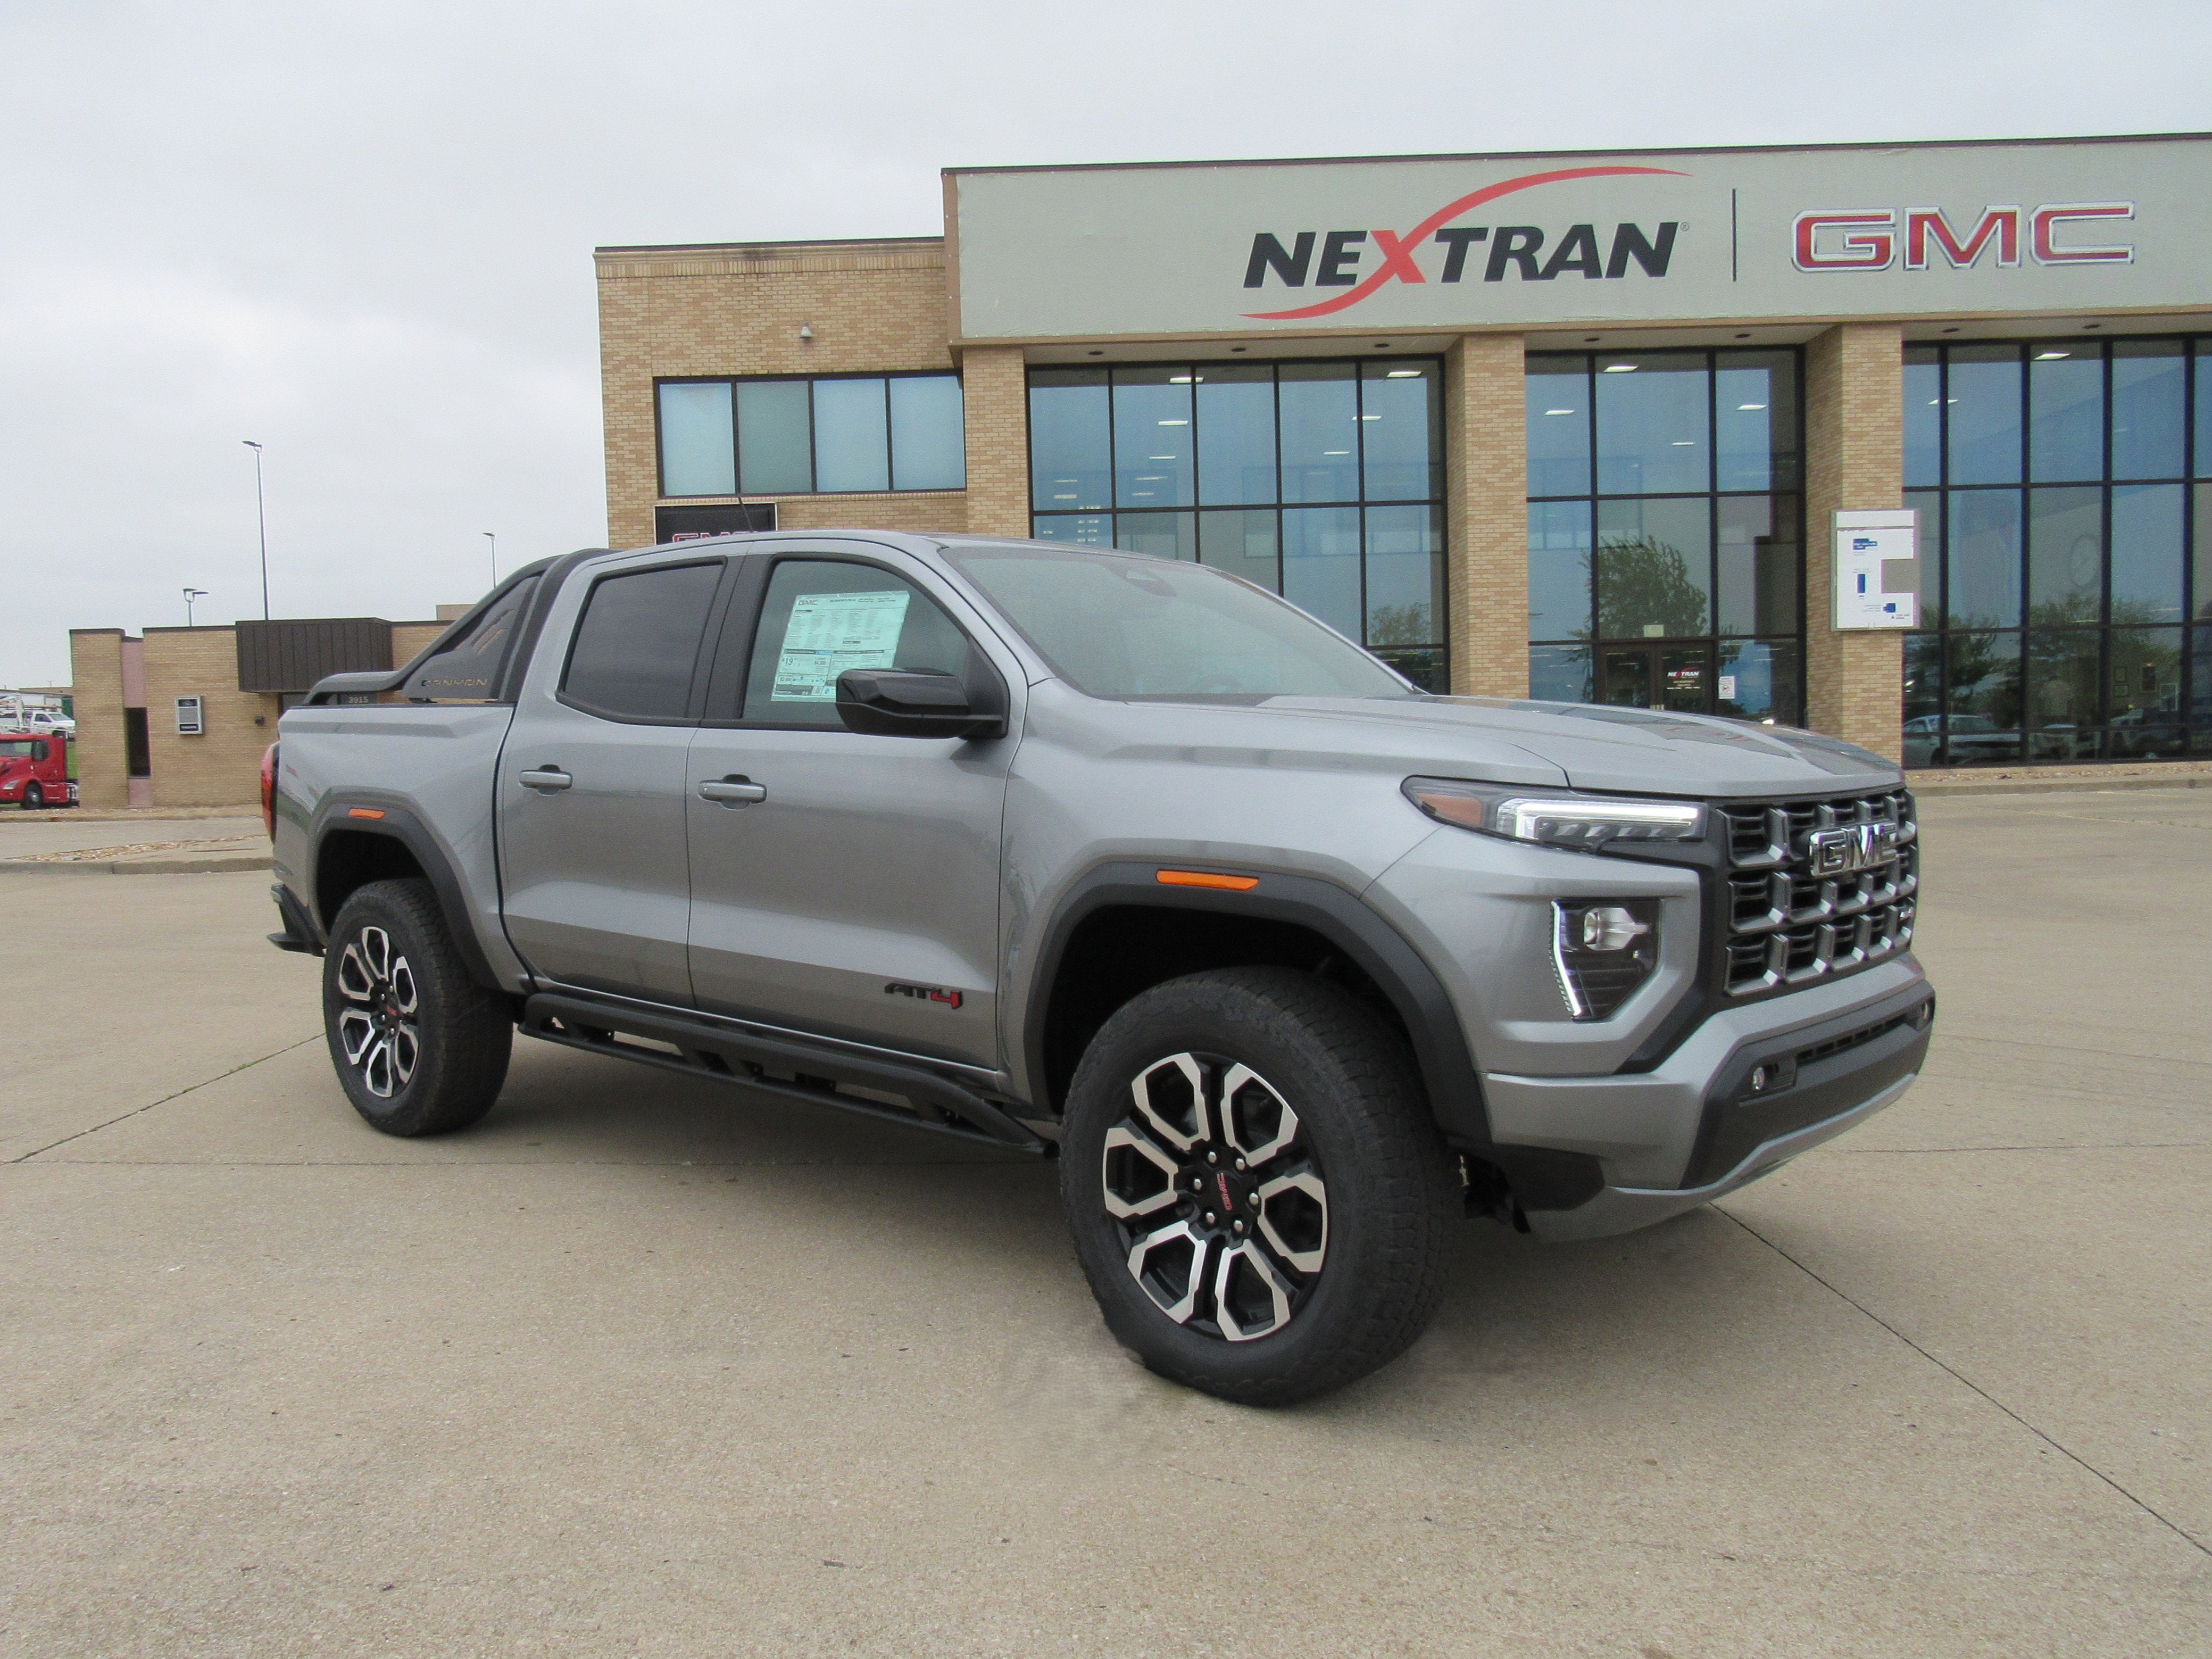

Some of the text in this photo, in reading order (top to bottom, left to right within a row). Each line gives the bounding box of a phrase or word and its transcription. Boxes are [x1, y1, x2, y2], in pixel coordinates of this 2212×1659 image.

[1243, 221, 1679, 288] NEXTRAN
[1791, 201, 2135, 272] GMC
[1809, 823, 1897, 877] GMC
[884, 981, 963, 1010] AT4
[1216, 1172, 1233, 1210] GMC
